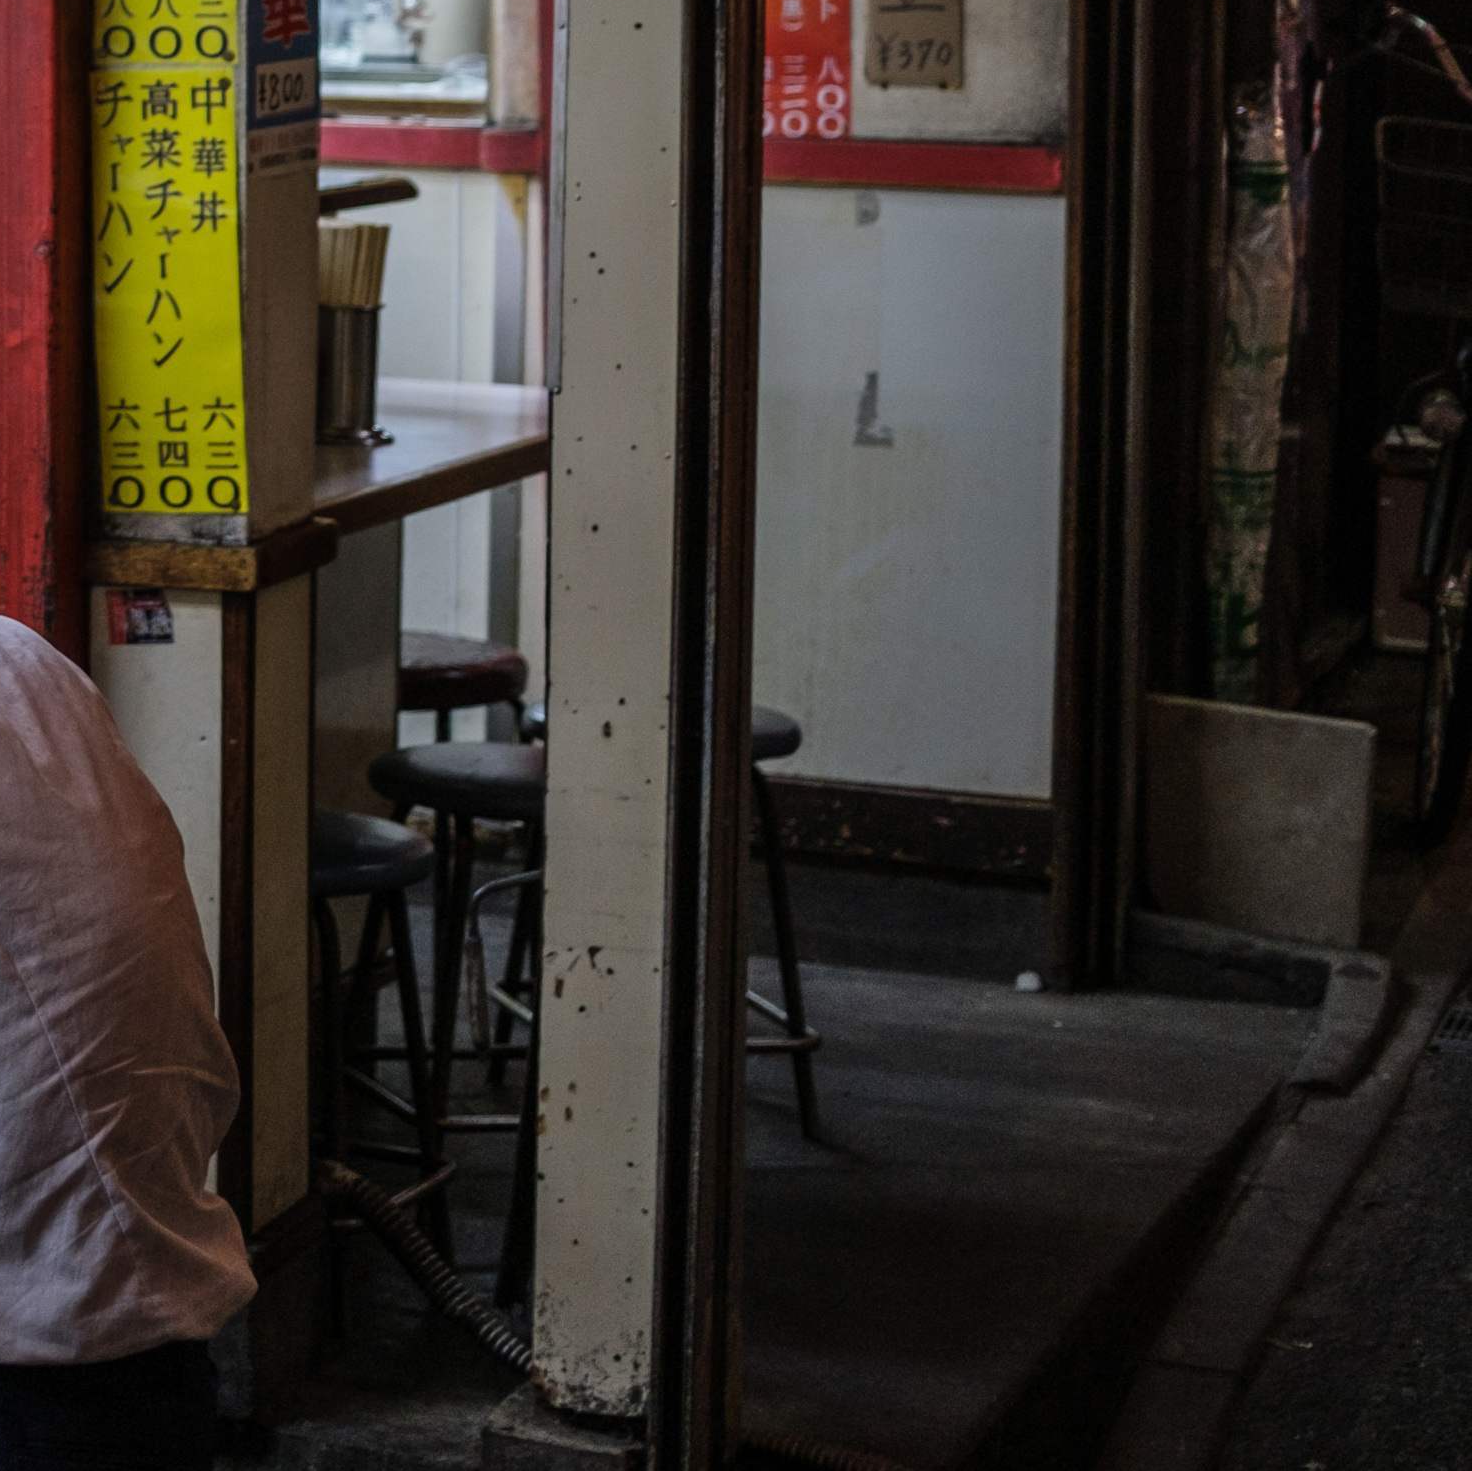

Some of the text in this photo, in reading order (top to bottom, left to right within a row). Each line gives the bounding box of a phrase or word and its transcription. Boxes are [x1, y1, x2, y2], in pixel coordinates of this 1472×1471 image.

[874, 31, 954, 71] ¥370
[95, 80, 146, 510] チャーハン 六三〇
[190, 78, 240, 510] 中華丼 六三〇
[153, 396, 193, 510] 七四〇
